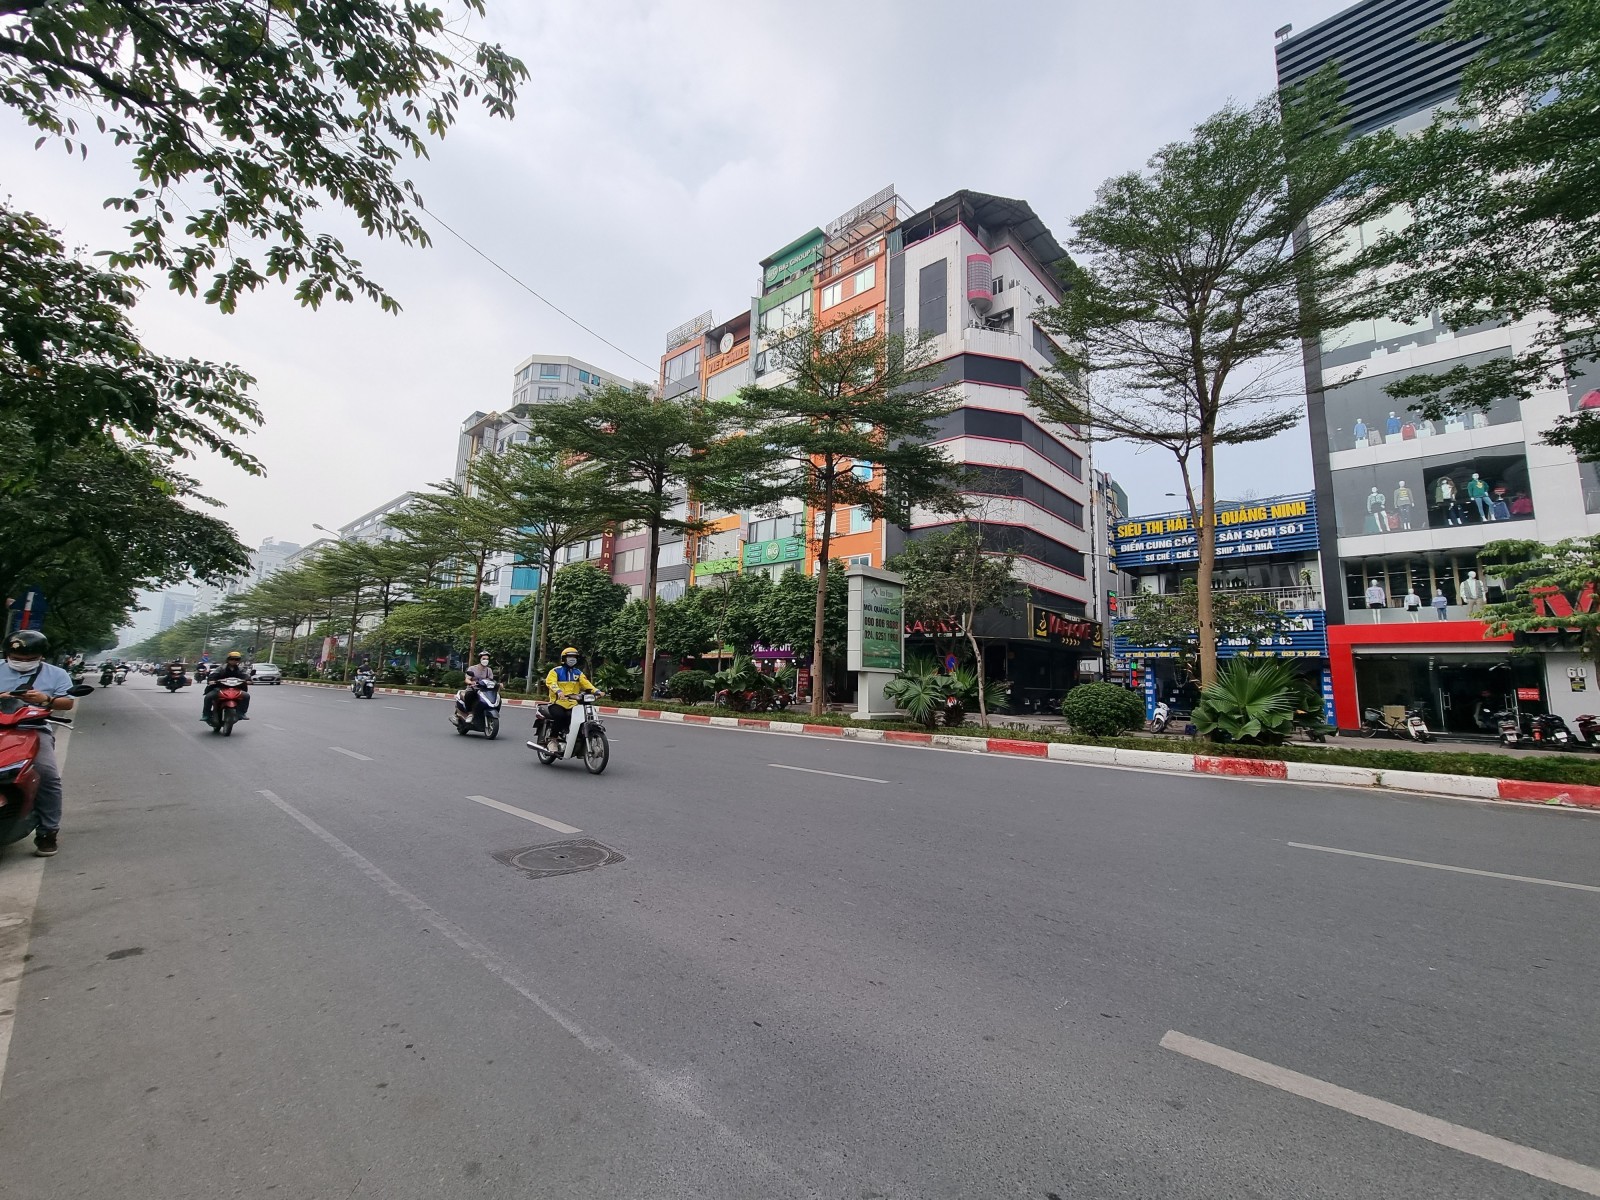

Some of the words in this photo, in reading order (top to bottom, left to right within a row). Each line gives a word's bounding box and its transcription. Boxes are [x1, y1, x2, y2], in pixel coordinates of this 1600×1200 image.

[778, 261, 789, 272] BIG
[1117, 522, 1142, 538] SIÊU
[1145, 521, 1164, 535] THỊ
[1166, 515, 1188, 532] HẢI
[1221, 505, 1267, 526] QUẢNG
[1270, 501, 1307, 519] NINH
[1120, 540, 1144, 552] ĐIỂM
[1146, 540, 1172, 550] CUNG
[1174, 535, 1195, 547] CẤP
[1219, 530, 1243, 542] SẢN
[1245, 527, 1276, 540] SẠCH
[1279, 522, 1297, 535] SỐ
[1297, 523, 1304, 533] 1
[1156, 551, 1170, 560] CHẾ
[1176, 548, 1192, 559] CHẾ
[1215, 546, 1235, 555] SHIP
[1567, 667, 1587, 678] 60
